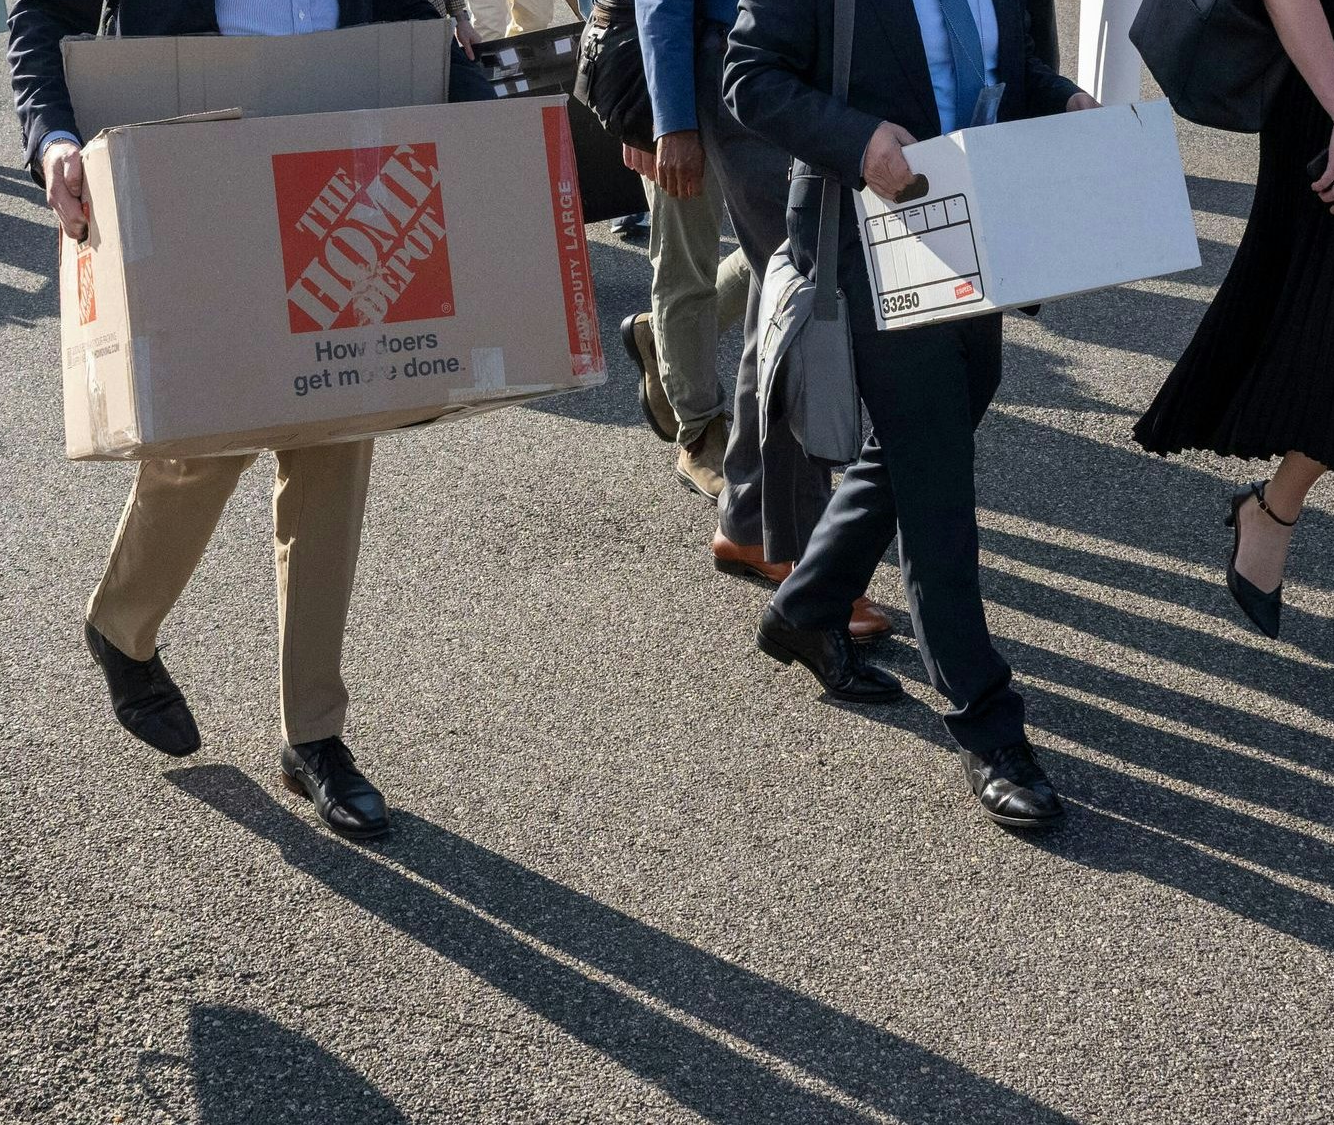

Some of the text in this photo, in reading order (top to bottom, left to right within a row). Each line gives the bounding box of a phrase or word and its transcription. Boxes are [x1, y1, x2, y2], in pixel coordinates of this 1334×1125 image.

[295, 167, 362, 240] THE
[558, 180, 579, 250] LARGE
[287, 144, 441, 330] HOME
[570, 259, 586, 304] DUTY
[882, 291, 920, 314] 33250
[294, 369, 332, 396] get
